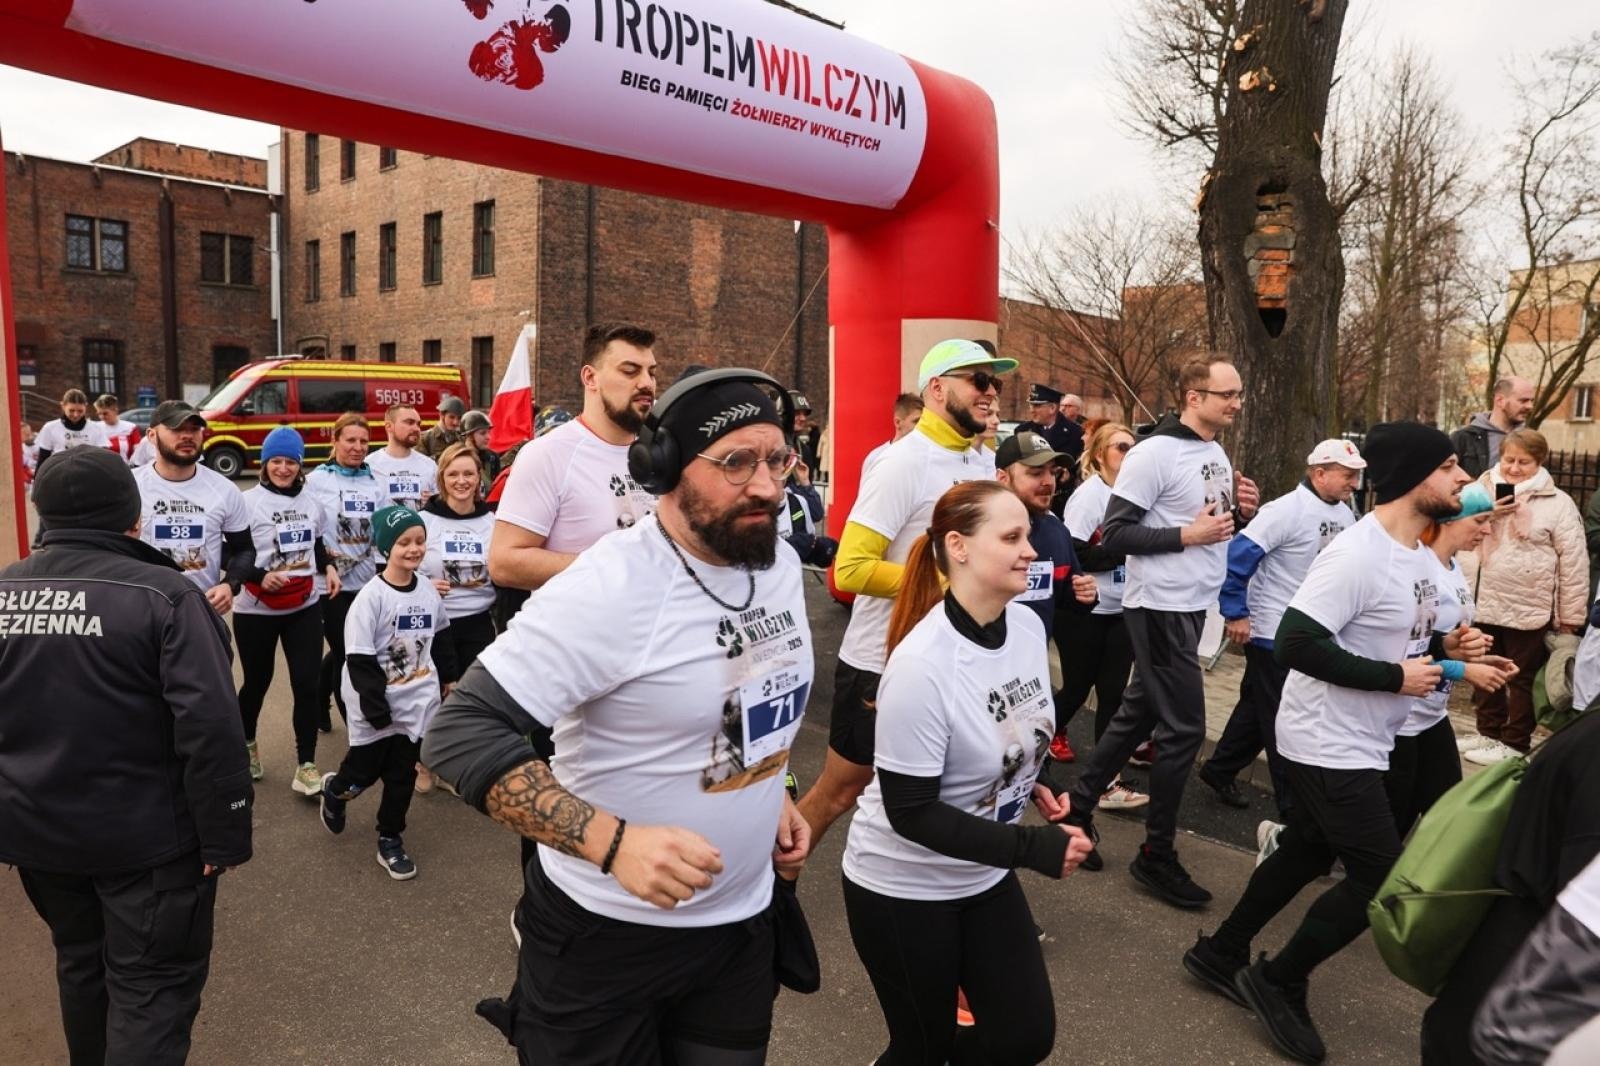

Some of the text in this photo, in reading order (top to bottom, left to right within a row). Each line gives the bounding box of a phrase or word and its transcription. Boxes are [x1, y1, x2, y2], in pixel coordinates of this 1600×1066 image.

[620, 70, 881, 151] BIEG PAMIĘCI ŻOŁNIERZY WYKLĘTYCH
[375, 389, 400, 405] 569
[354, 501, 369, 511] 95
[170, 526, 191, 539] 98
[290, 530, 305, 543] 97
[454, 542, 477, 553] 126
[0, 587, 86, 611] SŁUŻBA
[410, 615, 425, 629] 96
[740, 606, 766, 625] TROPEM
[0, 614, 103, 639] ĘZIENNA
[744, 610, 796, 643] WILCZYM
[1006, 676, 1042, 707] WILCZYM
[769, 692, 795, 730] 71
[230, 798, 246, 810] SW
